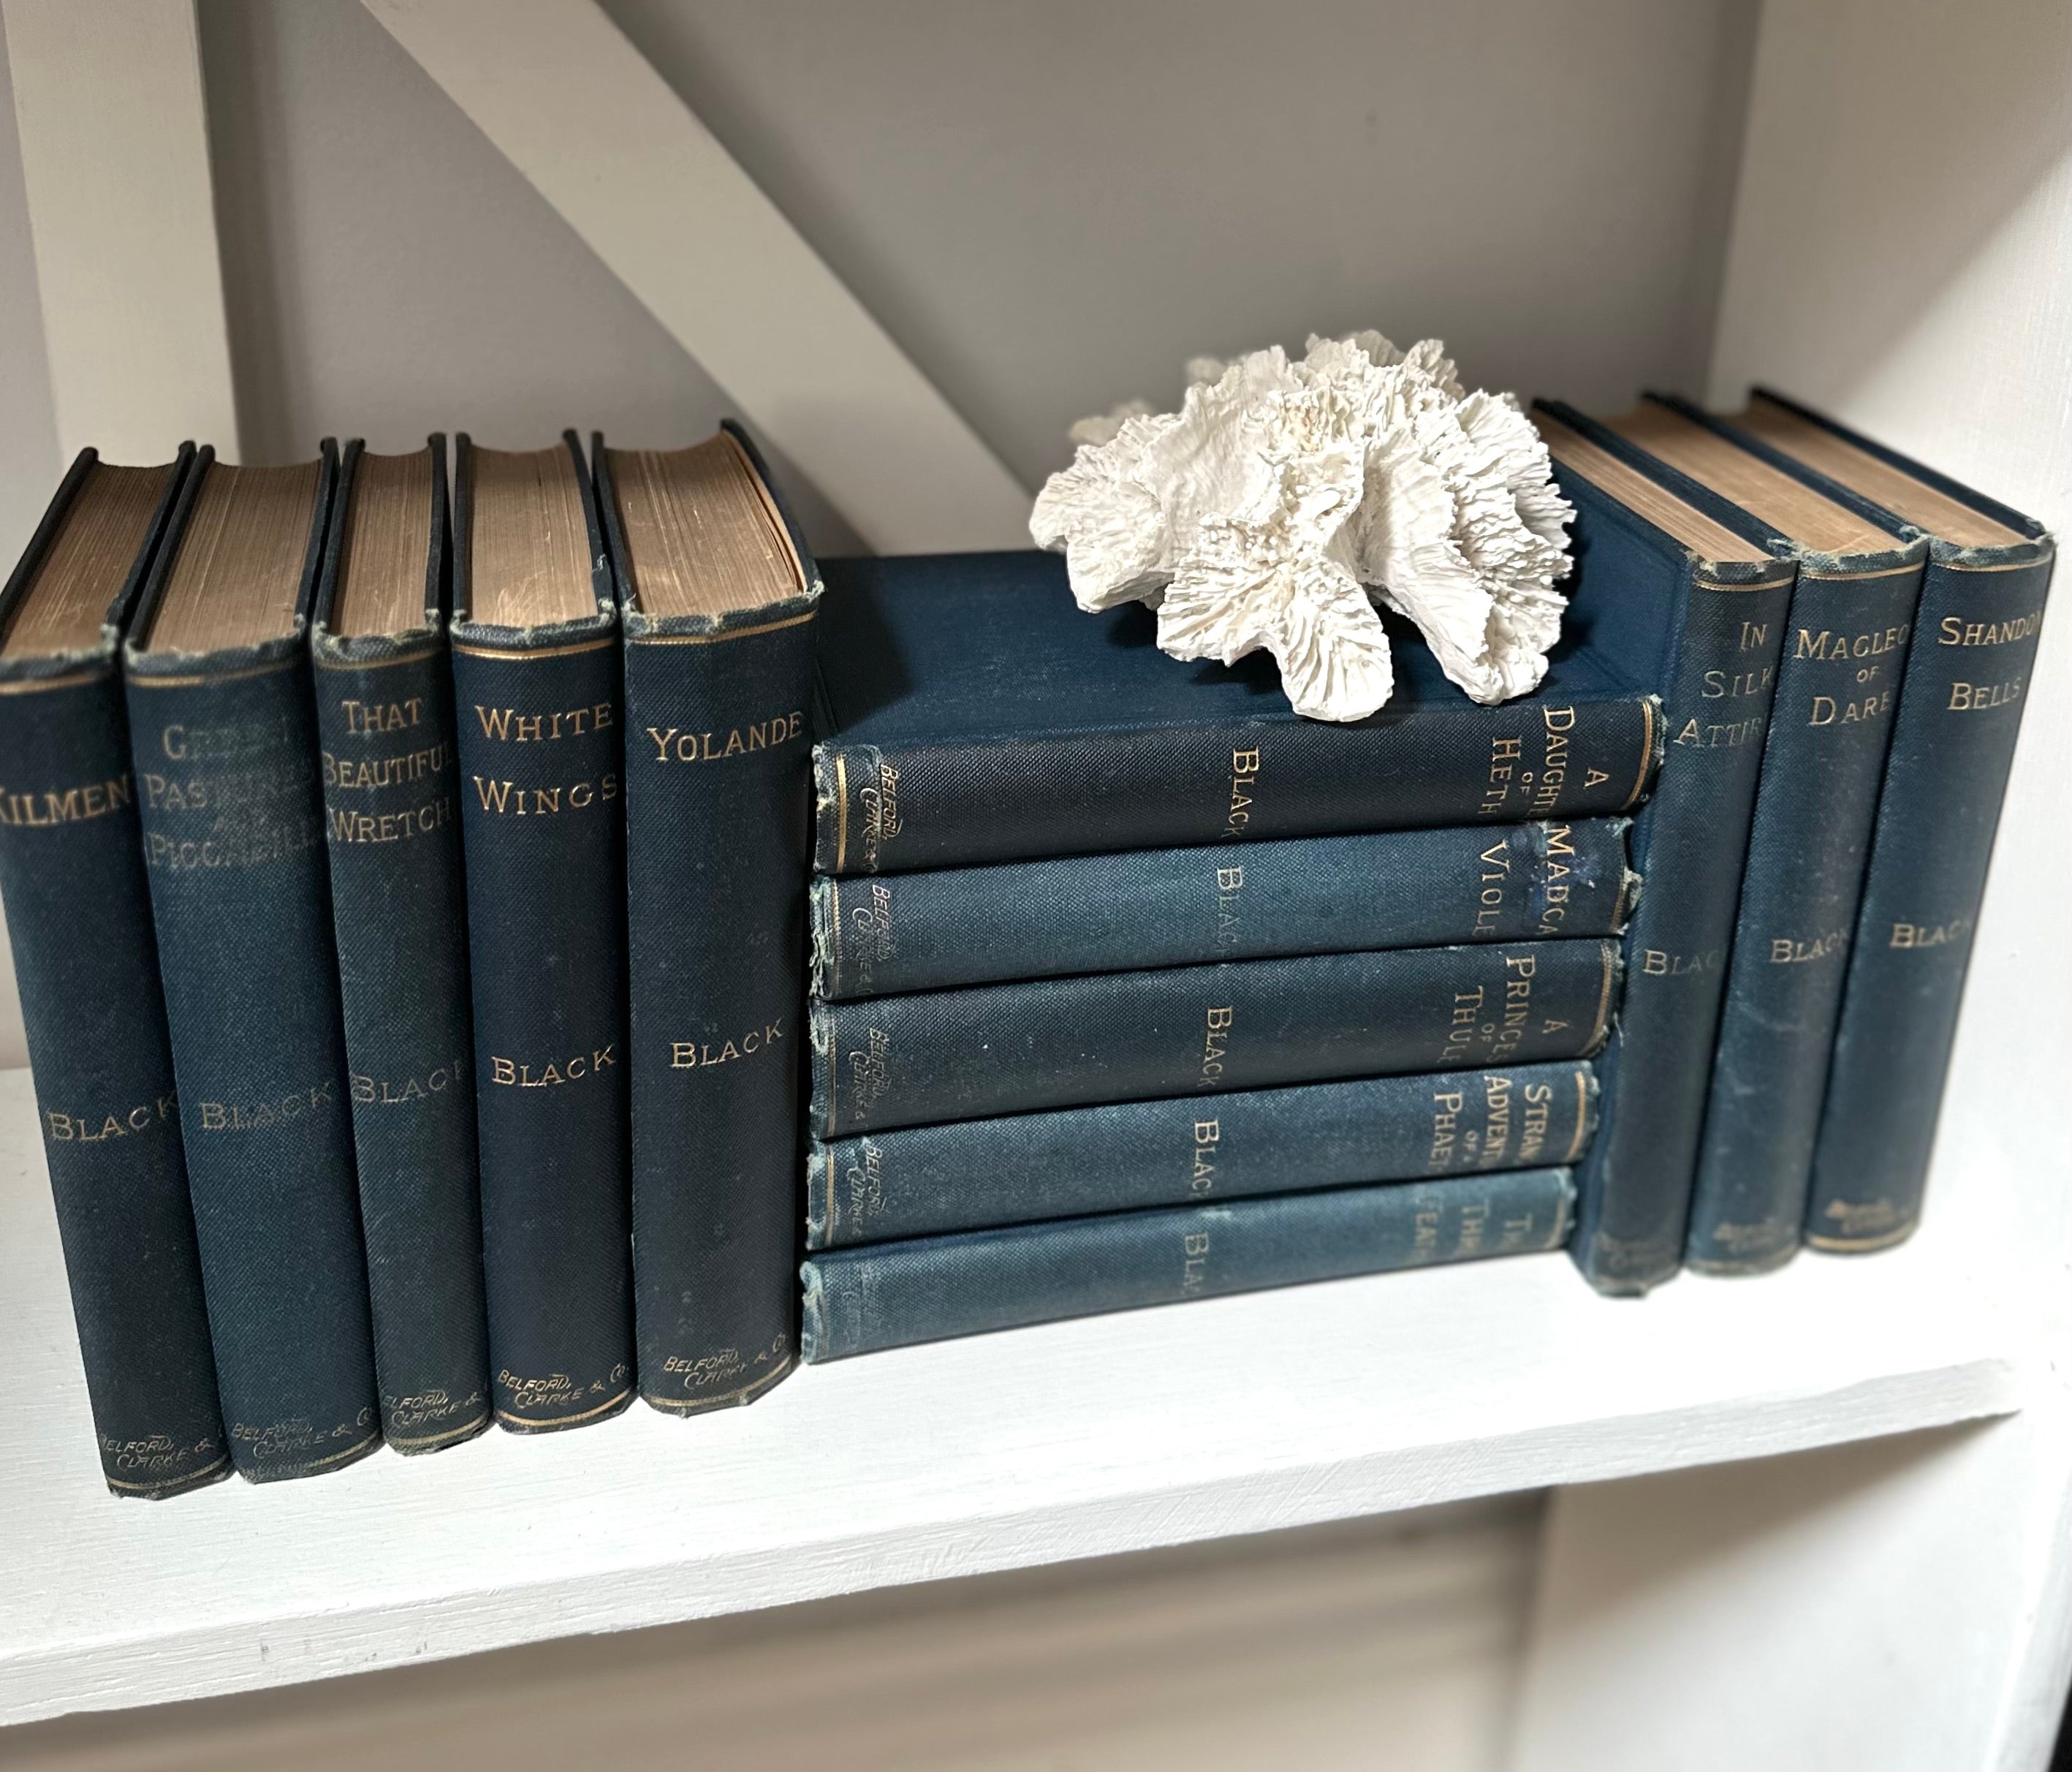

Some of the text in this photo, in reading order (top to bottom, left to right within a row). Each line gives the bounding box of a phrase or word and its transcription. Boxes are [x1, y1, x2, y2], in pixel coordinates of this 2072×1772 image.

[1739, 621, 1768, 653] IN
[1701, 665, 1774, 699] SILK
[1856, 666, 1880, 684] OF
[1809, 691, 1890, 727] DARE
[1947, 676, 2022, 711] BELLS
[341, 697, 422, 734] THAT
[474, 703, 613, 742] WHITE
[647, 711, 803, 762] YOLANDE
[1222, 746, 1259, 838] BLACK
[1478, 735, 1522, 815] HETH
[1519, 771, 1533, 795] OF
[1584, 766, 1609, 790] A
[473, 773, 617, 815] WINGS
[327, 797, 451, 842] WRETCH
[670, 1018, 784, 1069] BLACK
[1479, 1023, 1495, 1042] OF
[1542, 1020, 1573, 1034] A
[1196, 1006, 1232, 1088] BLACK
[491, 1045, 616, 1087] BLACK
[45, 1090, 178, 1140] BLACK
[200, 1081, 333, 1129] BLACK
[392, 1392, 482, 1427] CLARKE &
[515, 1387, 584, 1409] CLARKE
[589, 1379, 605, 1393] &
[332, 1423, 352, 1437] &
[117, 1438, 215, 1472] CLARKE &
